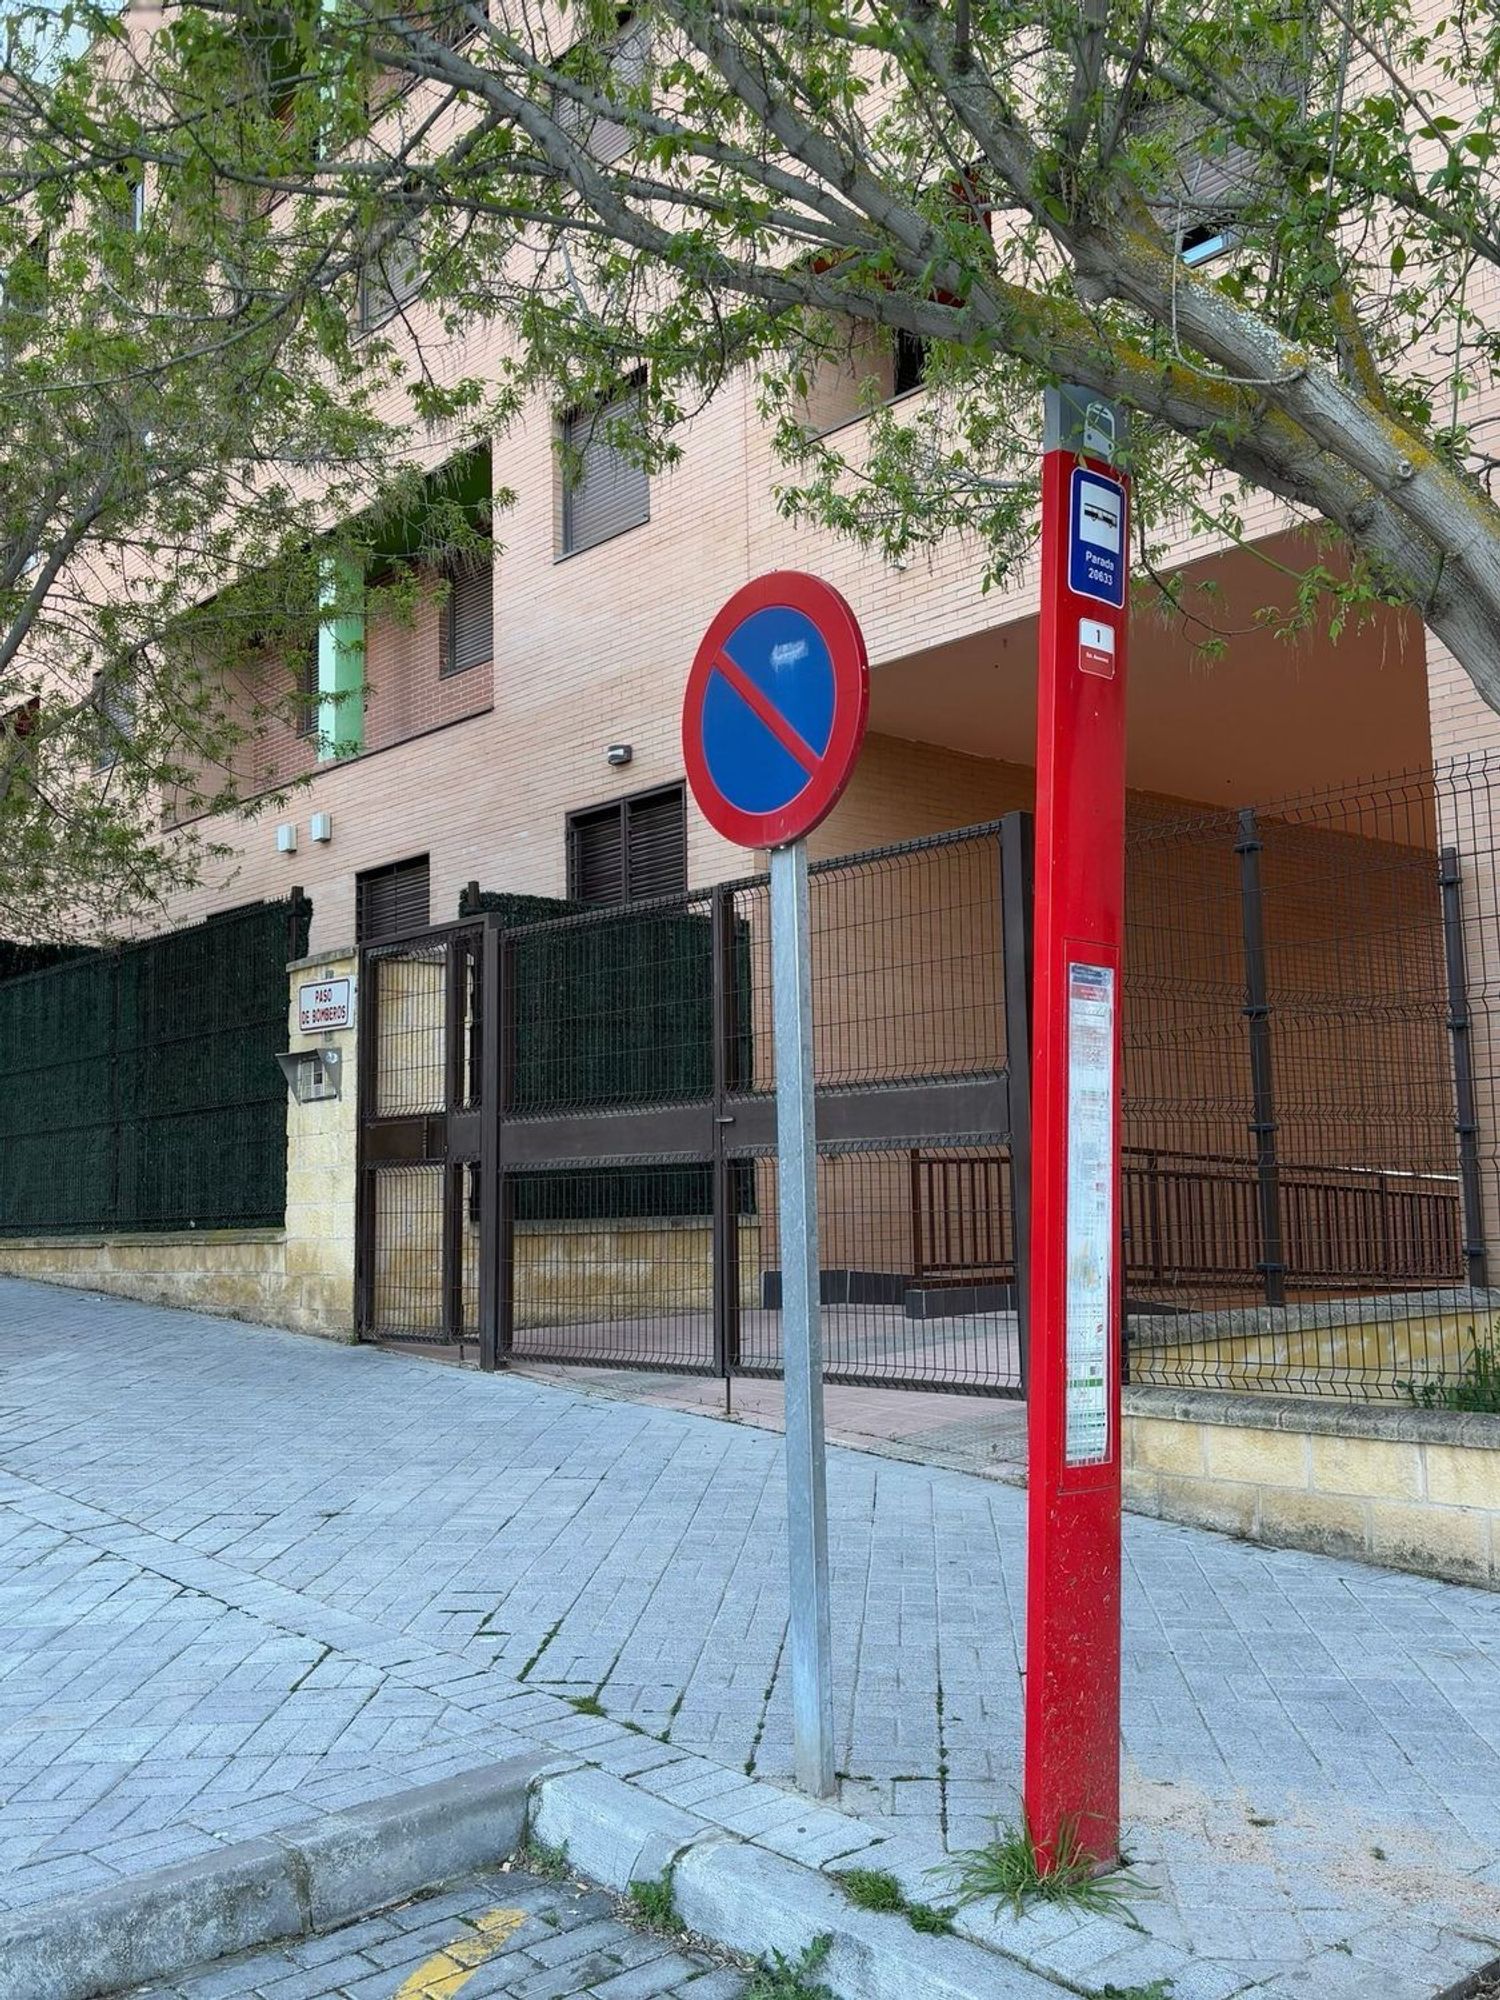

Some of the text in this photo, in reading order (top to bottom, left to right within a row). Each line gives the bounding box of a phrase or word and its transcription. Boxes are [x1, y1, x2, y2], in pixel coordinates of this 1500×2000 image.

[1085, 550, 1115, 571] Parada
[1088, 567, 1113, 586] 20633
[1096, 629, 1101, 643] 1
[315, 988, 333, 1003] PASO
[301, 1005, 346, 1025] DE BOMBEROS
